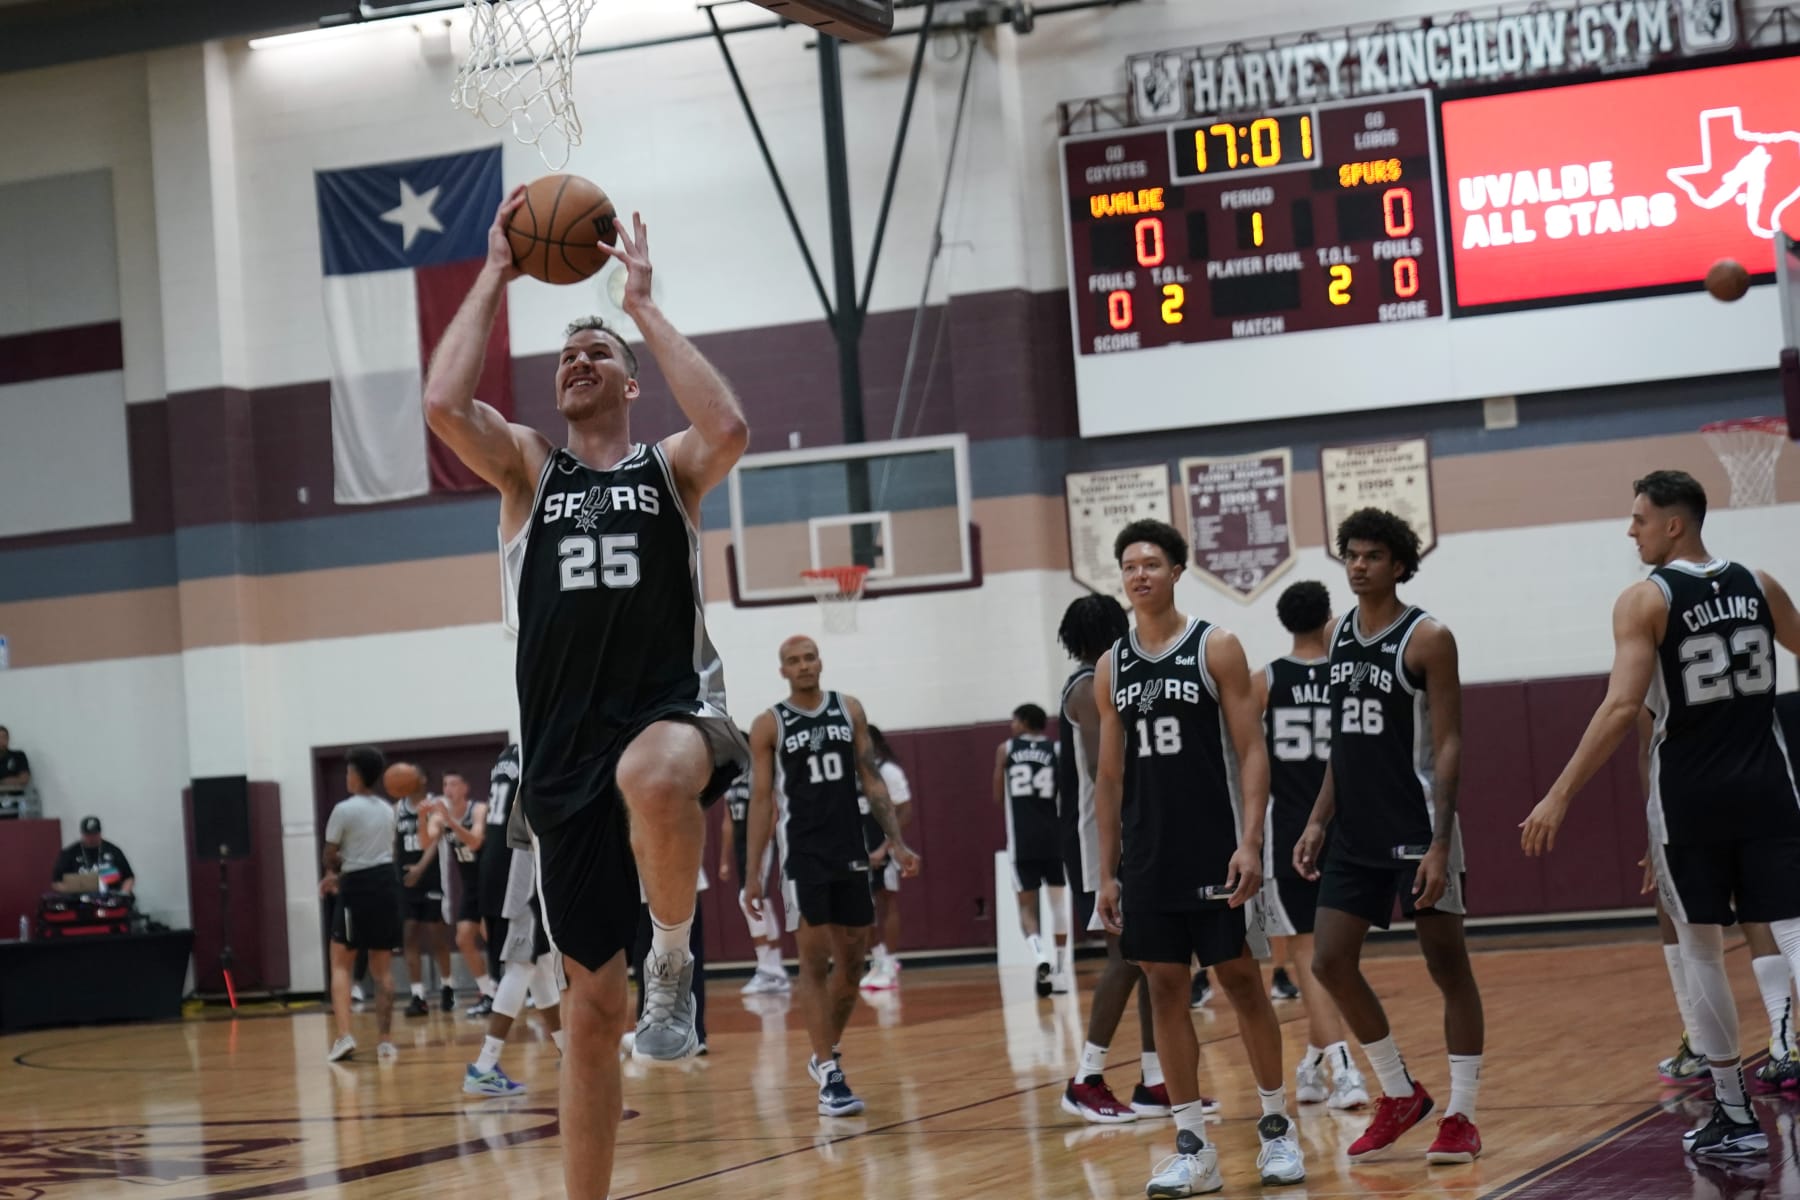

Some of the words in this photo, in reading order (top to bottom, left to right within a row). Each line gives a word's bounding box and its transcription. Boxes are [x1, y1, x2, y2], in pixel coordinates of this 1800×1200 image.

[1191, 40, 1349, 113] HARVEY
[1359, 13, 1566, 91] KINCHLOW
[1578, 0, 1673, 60] GYM
[1195, 115, 1313, 173] 17:01
[1085, 160, 1148, 184] COYOTES
[1339, 158, 1402, 188] SPURS
[1459, 160, 1615, 211] UVALDE
[1221, 186, 1275, 210] PERIOD
[1383, 187, 1414, 238] 0
[1252, 212, 1264, 246] 1
[1462, 209, 1537, 249] ALL
[1544, 192, 1678, 240] STARS
[1135, 217, 1165, 267] 0
[1373, 237, 1423, 260] FOULS
[1088, 271, 1136, 293] FOULS
[1206, 255, 1263, 280] PLAYER
[1265, 251, 1304, 274] FOUL
[1393, 256, 1419, 298] 0
[1161, 283, 1185, 324] 2
[1328, 264, 1352, 306] 2
[1108, 290, 1133, 330] 0
[1232, 316, 1285, 338] MATCH
[1378, 300, 1428, 322] SCORE
[1094, 332, 1141, 354] SCORE
[543, 484, 660, 528] SPURS
[558, 532, 641, 592] 25
[1682, 595, 1759, 633] COLLINS
[1330, 661, 1393, 694] SPURS
[1678, 624, 1775, 706] 23
[1116, 678, 1199, 713] SPURS
[1292, 683, 1331, 704] HALL
[1272, 707, 1332, 762] 55
[1341, 697, 1384, 735] 26
[785, 725, 852, 753] SPURS
[1136, 716, 1182, 758] 18
[807, 752, 843, 783] 10
[1009, 763, 1054, 798] 24
